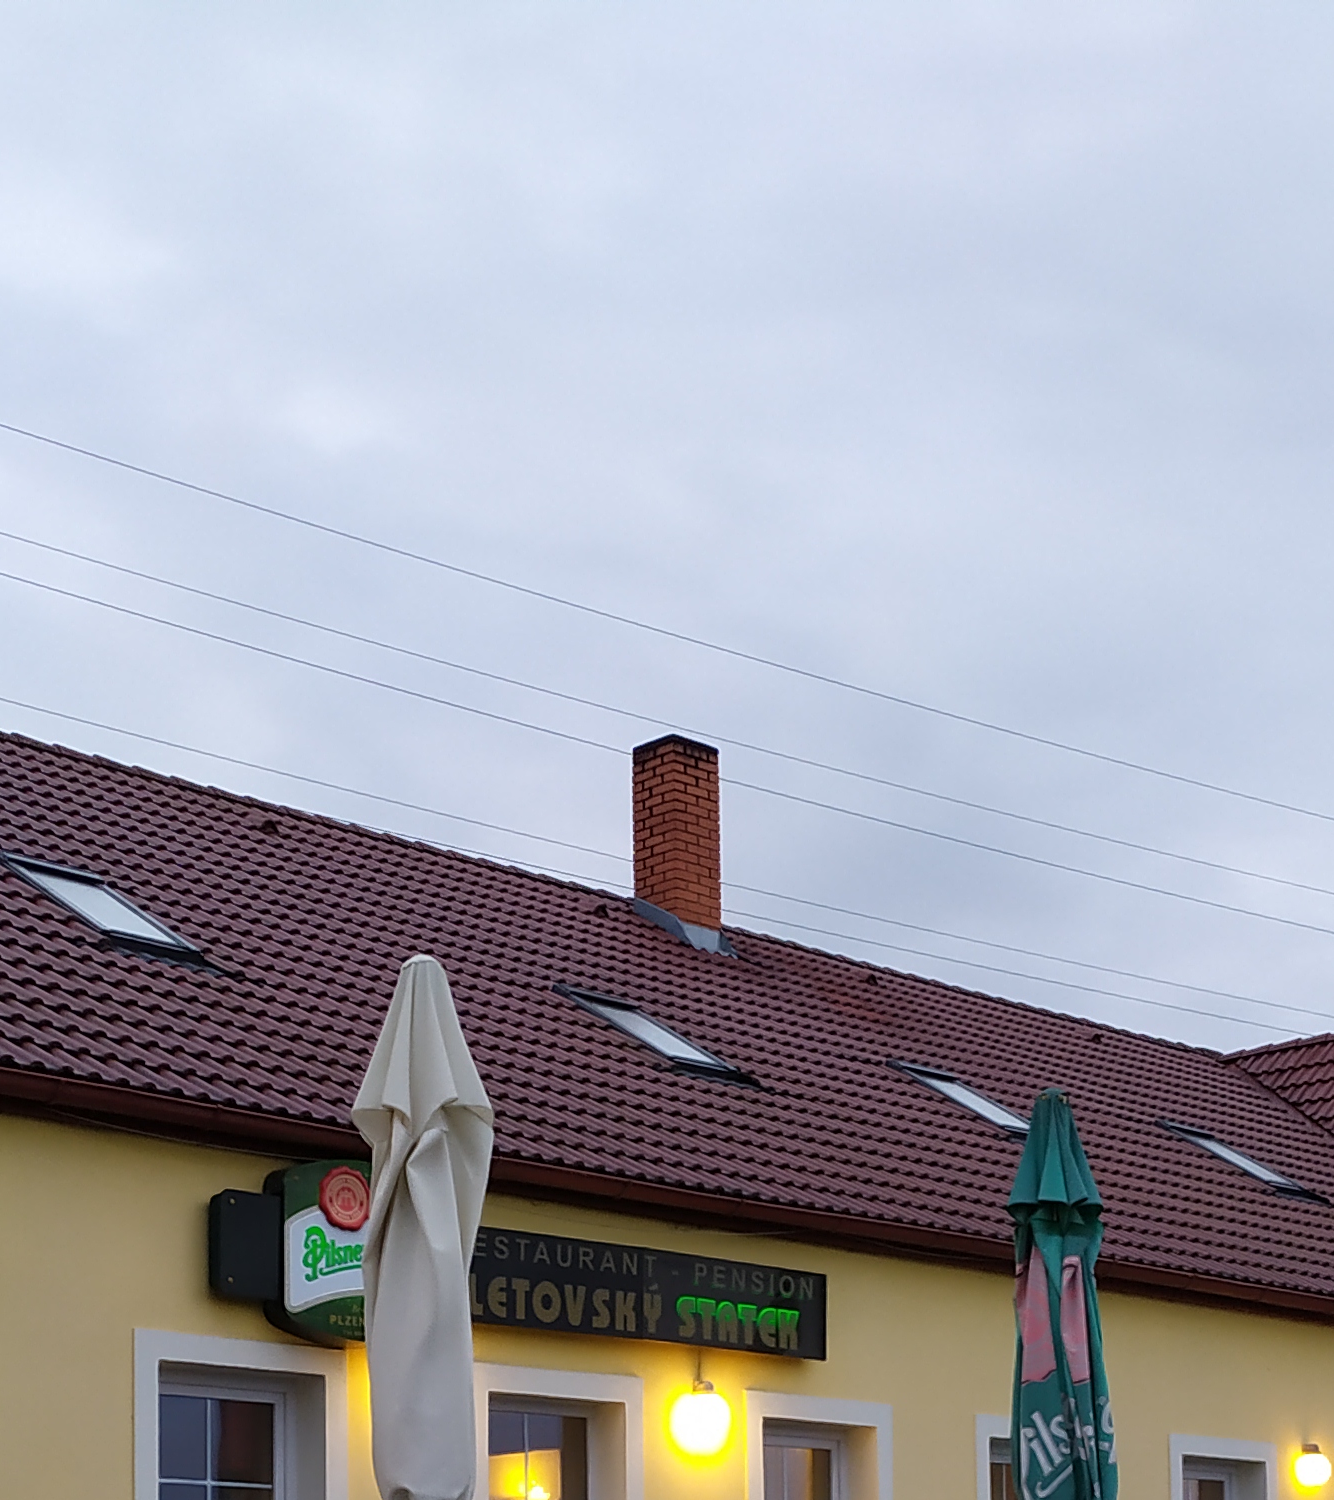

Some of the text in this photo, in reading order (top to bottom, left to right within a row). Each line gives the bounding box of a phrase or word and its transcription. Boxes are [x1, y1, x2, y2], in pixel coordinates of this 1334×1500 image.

[303, 1226, 364, 1282] Pilsne
[474, 1233, 657, 1279] ESTAURANT
[694, 1262, 814, 1301] PENSION
[675, 1294, 802, 1350] STATEK
